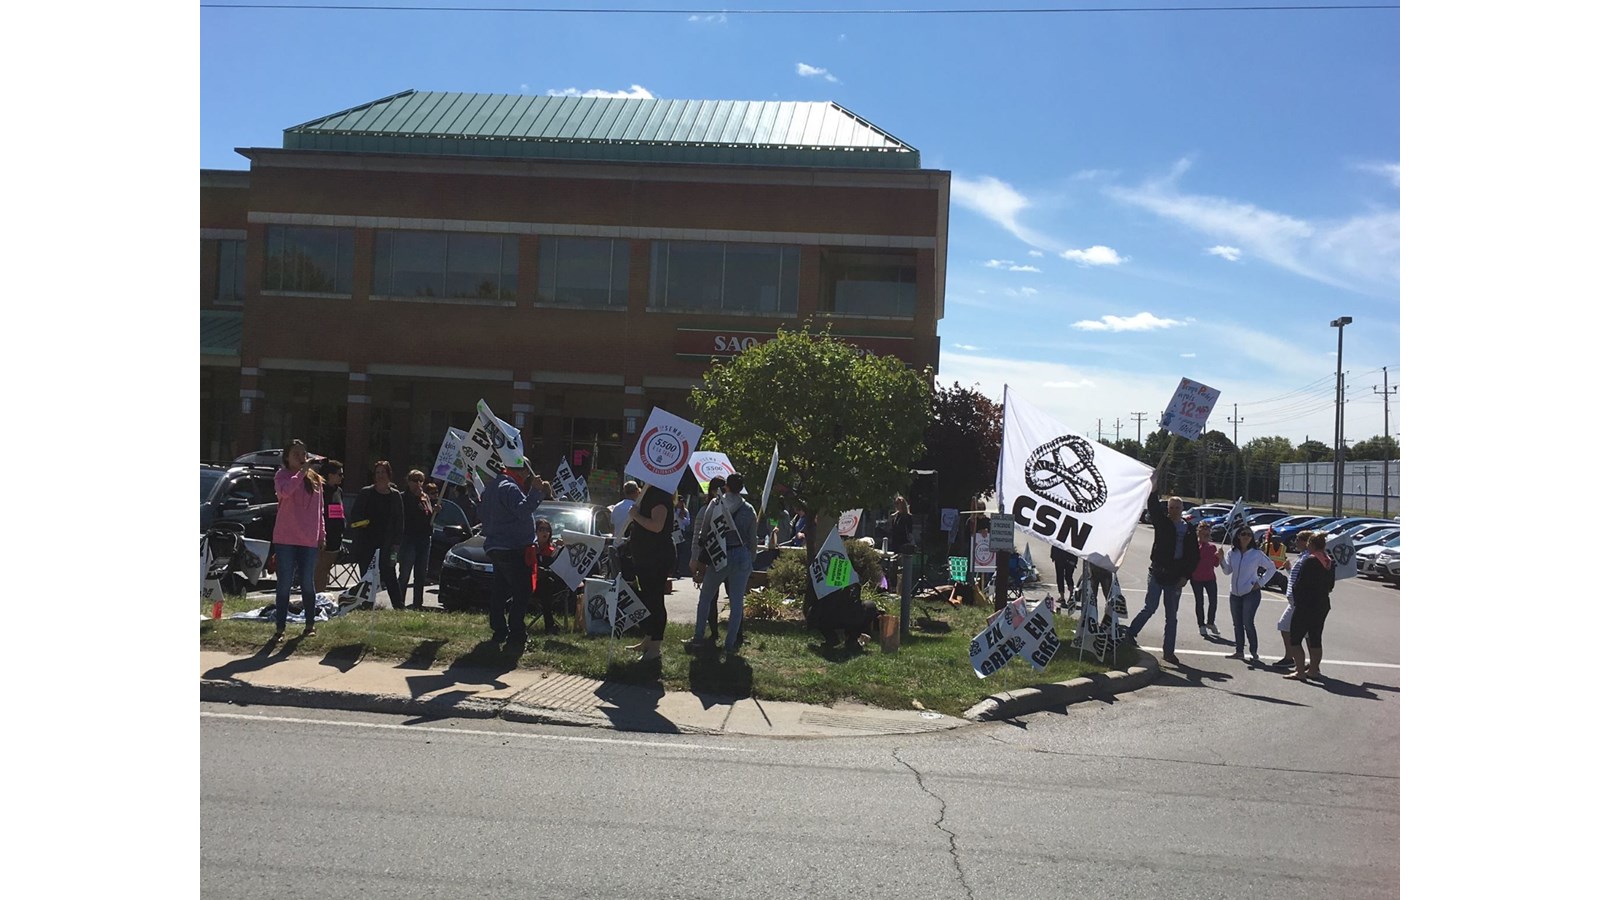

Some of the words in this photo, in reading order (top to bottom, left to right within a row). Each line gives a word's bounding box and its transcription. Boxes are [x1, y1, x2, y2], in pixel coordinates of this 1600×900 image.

[1180, 401, 1196, 417] 12
[472, 428, 491, 450] EN
[655, 438, 677, 453] 5500
[559, 467, 571, 481] EN
[713, 514, 730, 540] EN
[1012, 495, 1093, 551] CSN
[577, 548, 597, 574] CSN
[985, 623, 1004, 649] EN
[1024, 613, 1049, 640] EN
